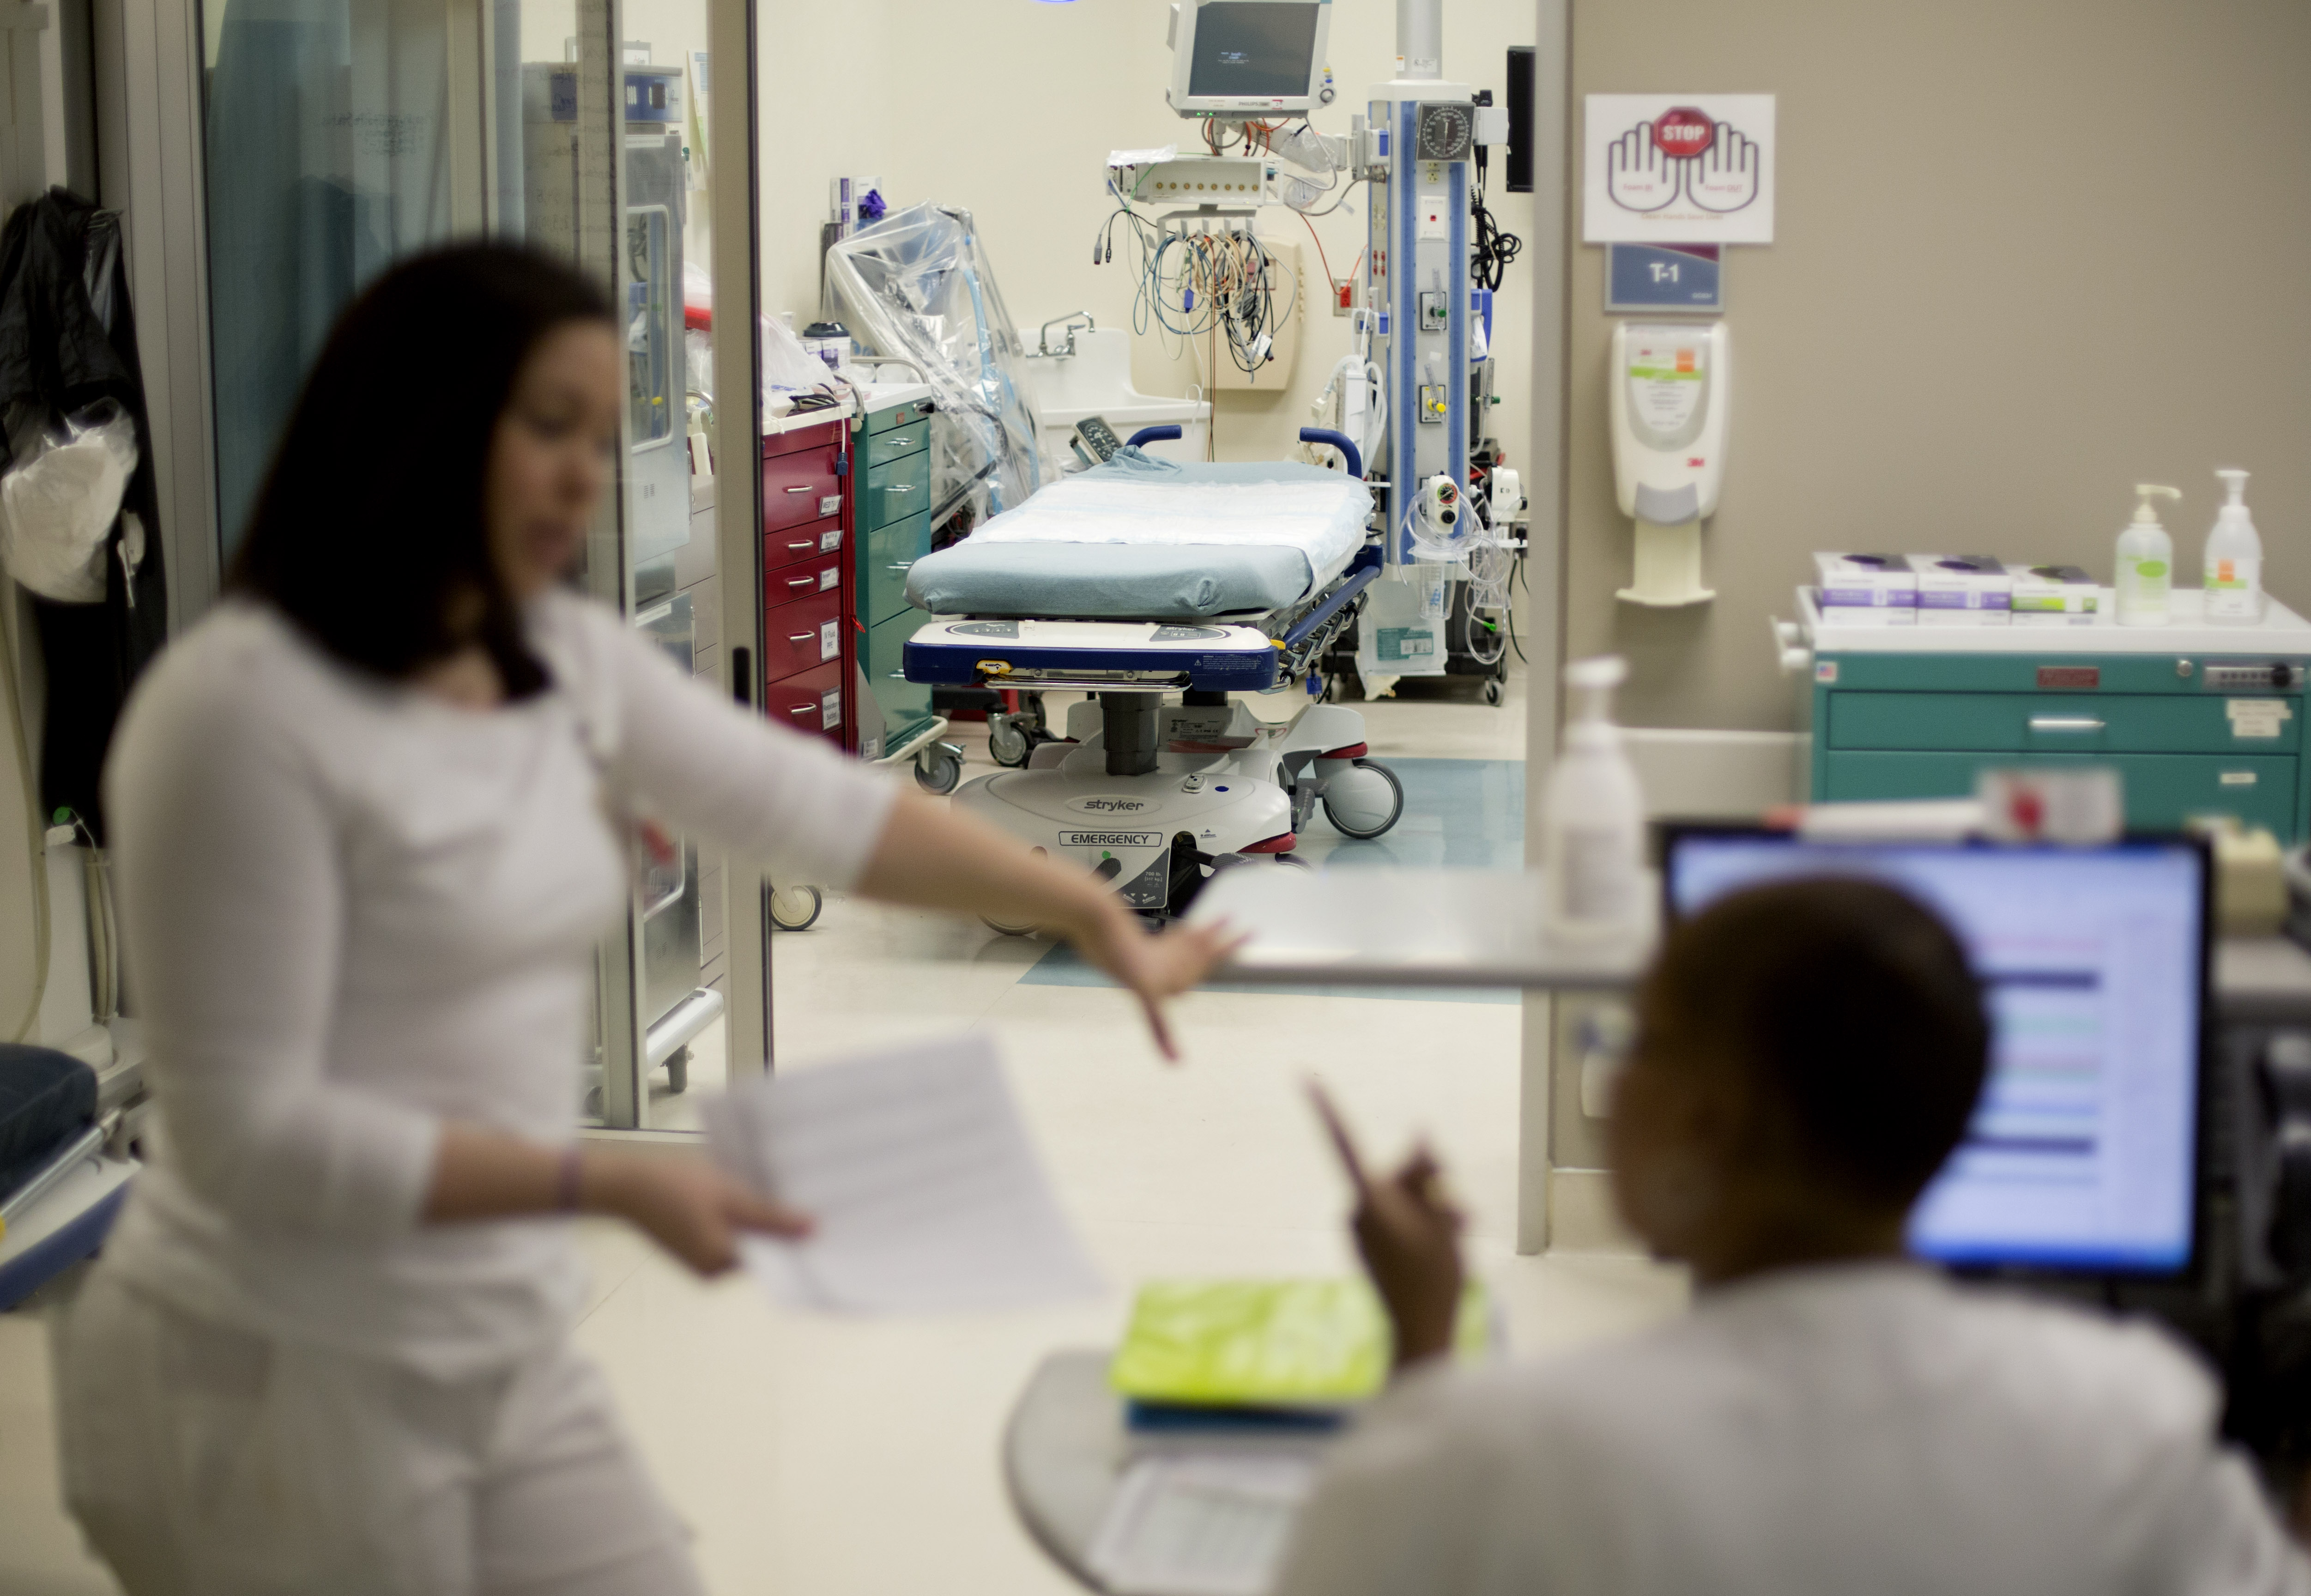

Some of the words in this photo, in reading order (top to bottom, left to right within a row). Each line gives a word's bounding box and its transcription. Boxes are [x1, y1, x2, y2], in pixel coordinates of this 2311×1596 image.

[1663, 125, 1705, 140] STOP
[1649, 263, 1679, 282] T-1
[1084, 799, 1143, 811] stryker
[1071, 834, 1149, 844] EMERGENCY
